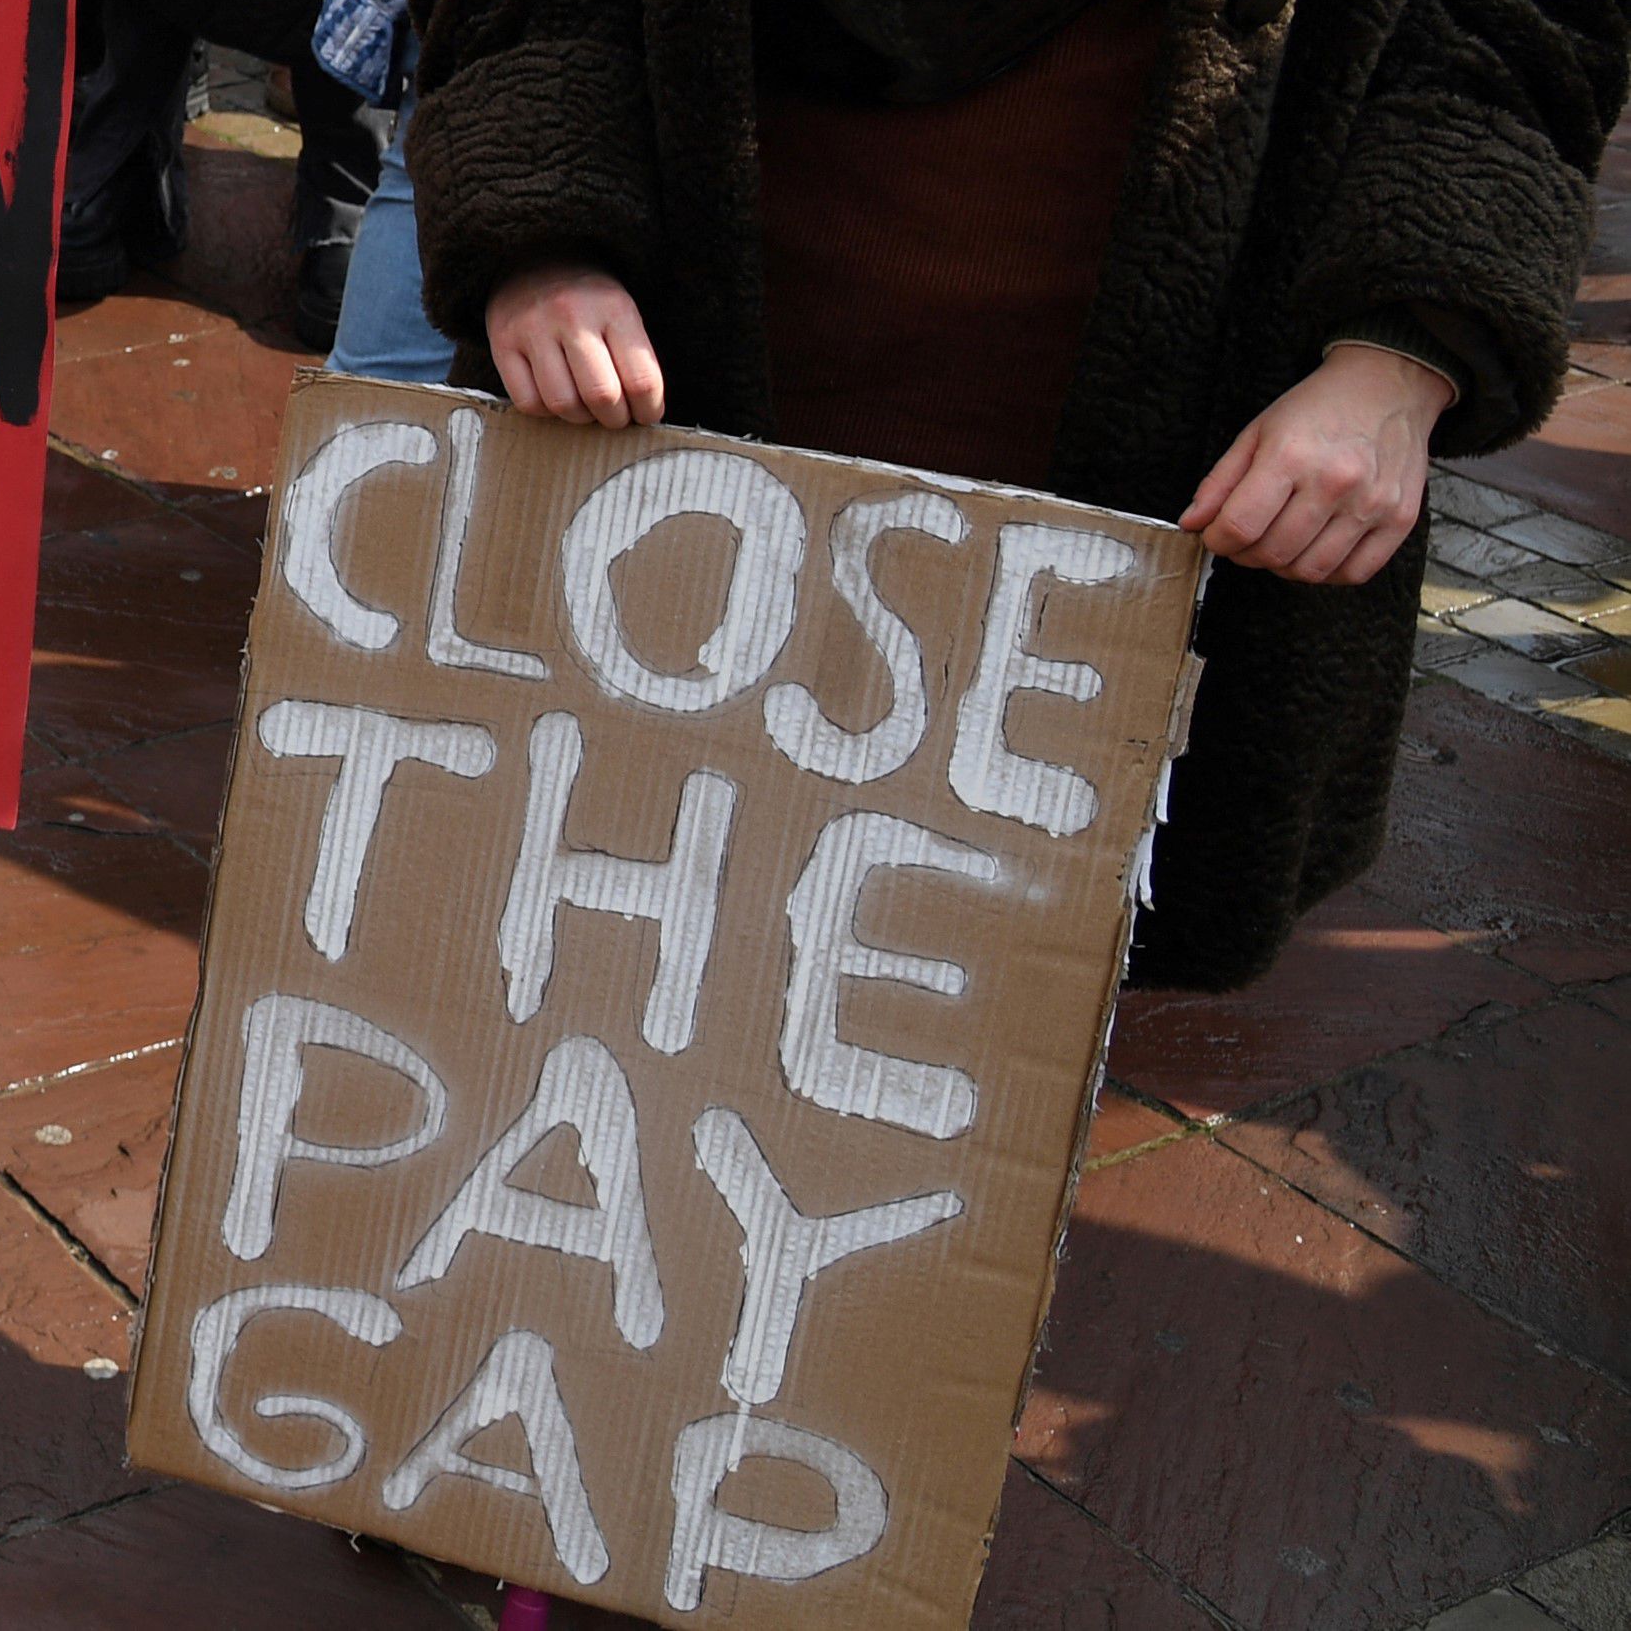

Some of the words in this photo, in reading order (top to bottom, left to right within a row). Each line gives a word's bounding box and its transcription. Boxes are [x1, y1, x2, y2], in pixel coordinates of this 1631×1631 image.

[280, 406, 1137, 839] CLOSE
[256, 697, 997, 1141] THE
[222, 991, 964, 1404] PAY
[186, 1283, 889, 1611] GAP
